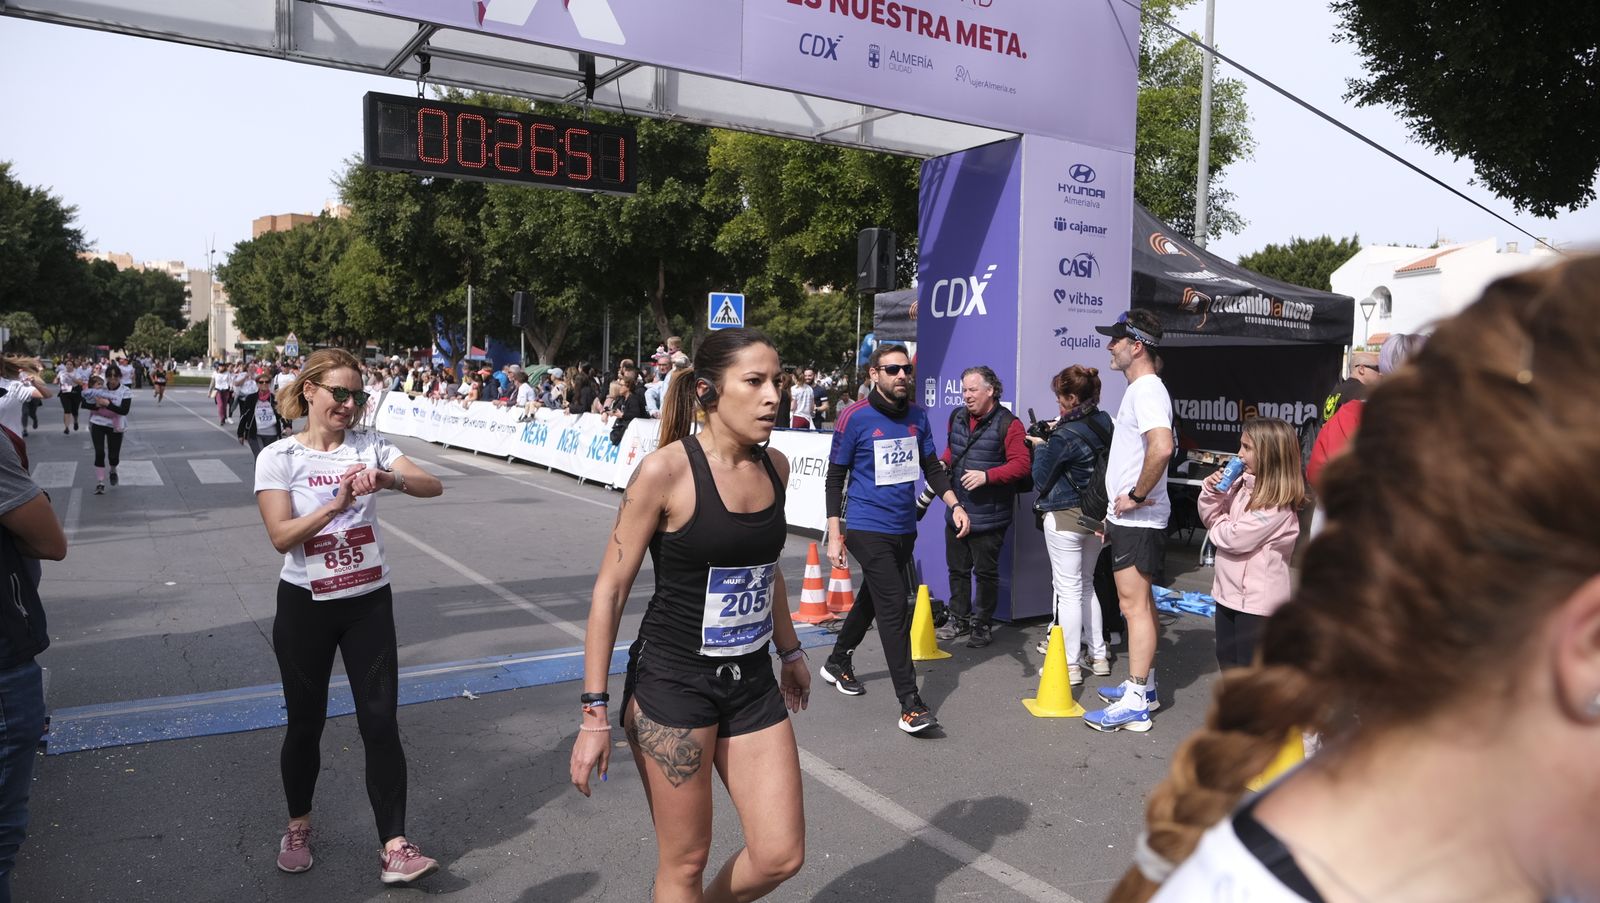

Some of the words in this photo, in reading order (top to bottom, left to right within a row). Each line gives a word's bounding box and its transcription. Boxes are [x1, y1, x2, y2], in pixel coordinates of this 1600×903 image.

[829, 0, 951, 42] NUESTRA
[956, 19, 1028, 59] META.
[889, 49, 934, 70] ALMERÍA
[888, 62, 913, 74] CIUDAD
[1058, 183, 1106, 199] HYUNDAI
[1069, 220, 1108, 235] cajamar
[930, 264, 998, 319] CDX
[1068, 291, 1104, 306] vithas
[1060, 334, 1101, 351] aqualia
[882, 450, 914, 465] 1224
[324, 546, 364, 569] 855
